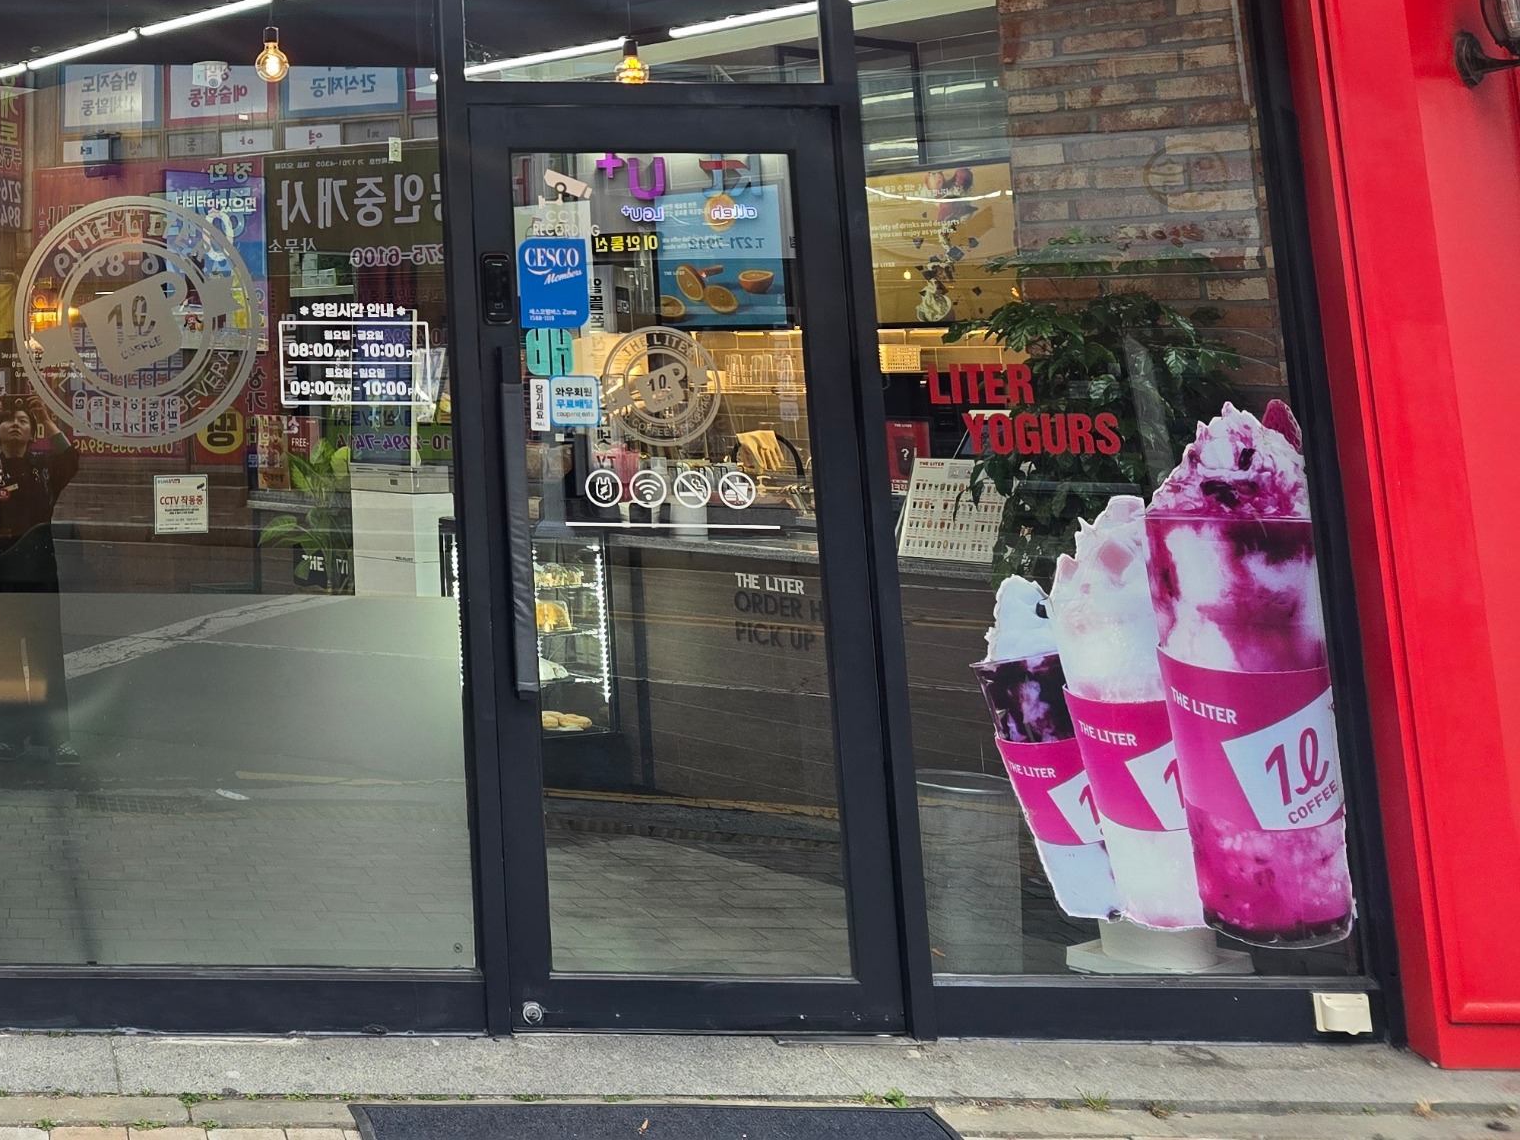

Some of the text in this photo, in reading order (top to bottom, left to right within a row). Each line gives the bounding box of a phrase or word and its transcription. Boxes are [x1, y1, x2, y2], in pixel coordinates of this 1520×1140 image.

[899, 222, 920, 230] drinks
[933, 219, 960, 227] desserts
[903, 230, 921, 239] enjoy
[524, 247, 580, 268] CESCO
[543, 267, 583, 286] Members
[310, 302, 395, 318] 영업시간 안내
[621, 336, 648, 358] THE
[555, 386, 593, 397] 와우회원
[927, 363, 1035, 405] LITER
[556, 398, 593, 409] 무료배달
[961, 412, 1123, 456] YOGURS
[160, 495, 204, 506] CCTV 작동중
[735, 572, 805, 595] THE LITER
[734, 590, 804, 619] ORDER
[735, 620, 817, 652] PICK UP
[1170, 686, 1238, 727] THE LITER
[1078, 719, 1138, 748] THE LITER
[1008, 760, 1057, 780] THE LITER
[1287, 779, 1339, 825] COFFEE
